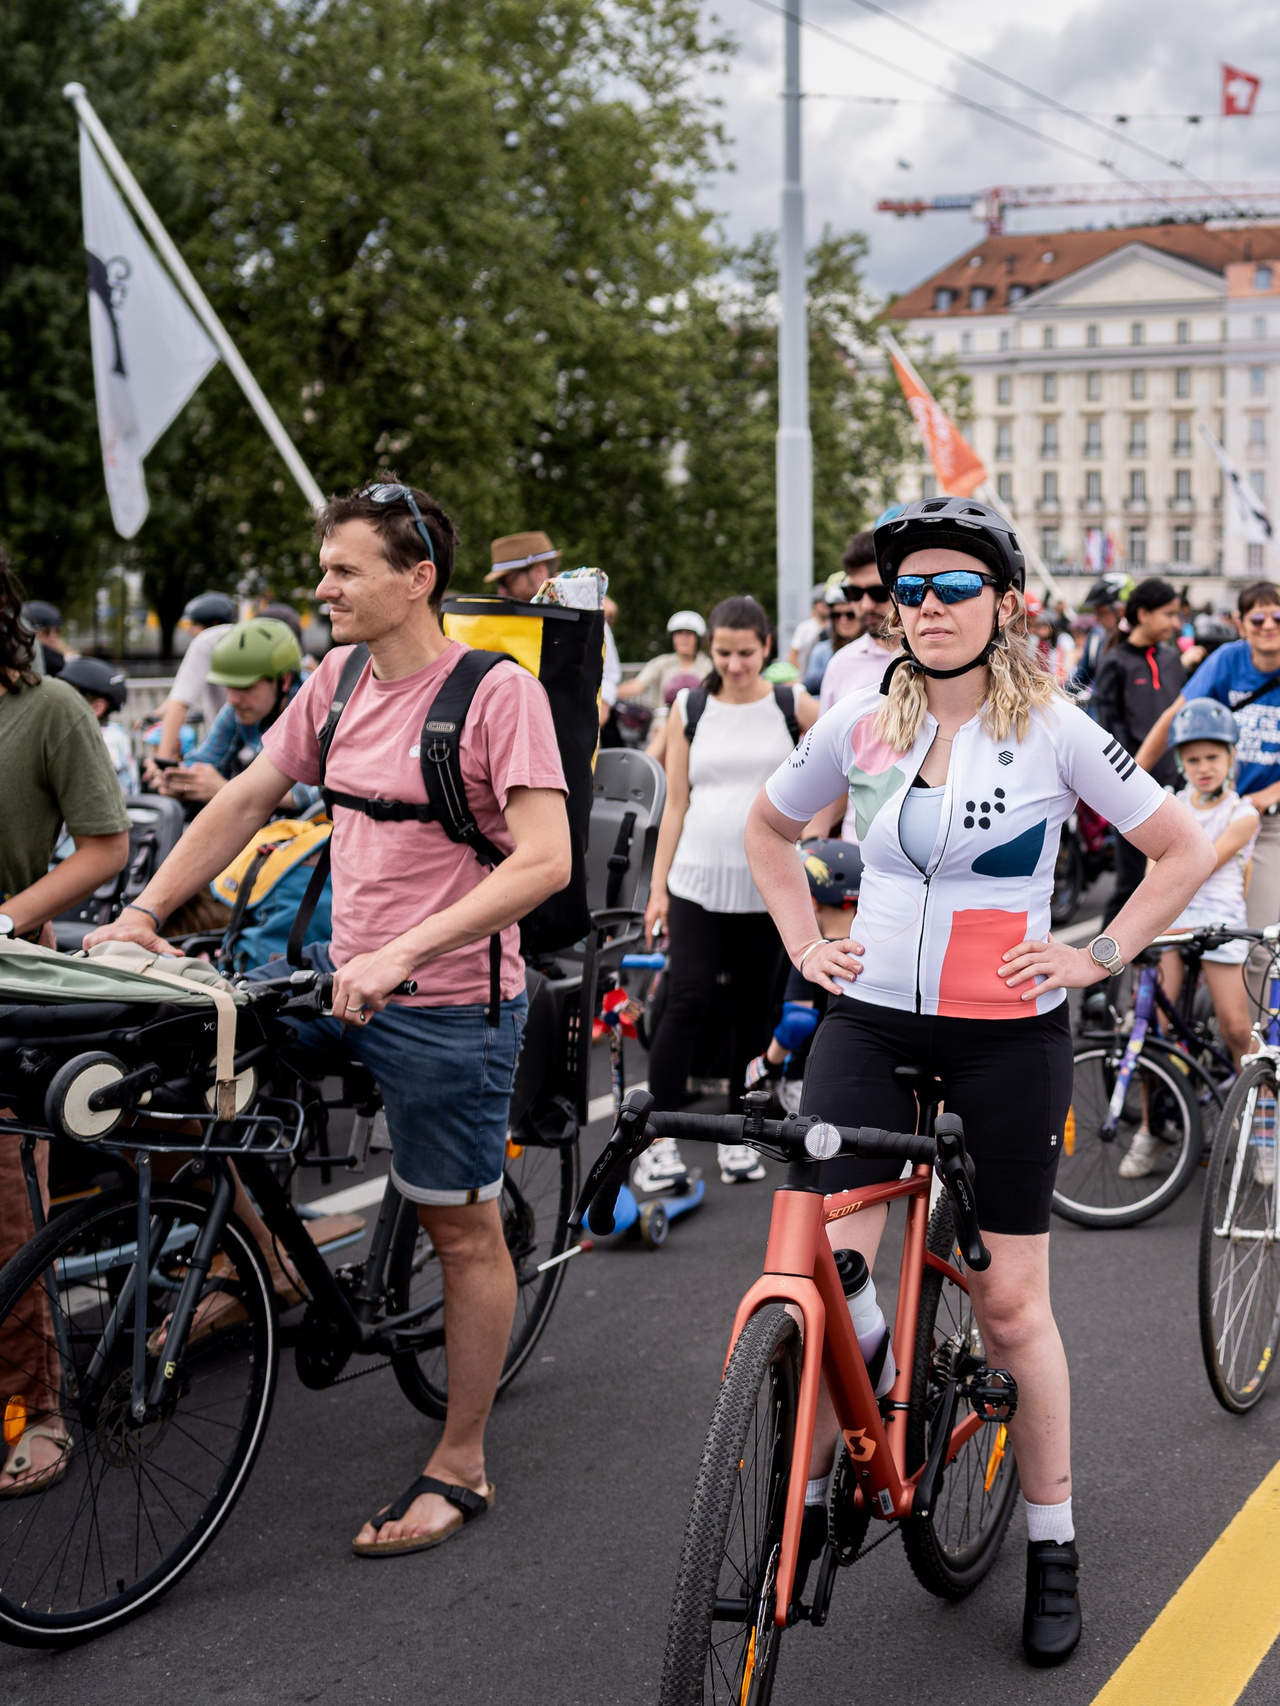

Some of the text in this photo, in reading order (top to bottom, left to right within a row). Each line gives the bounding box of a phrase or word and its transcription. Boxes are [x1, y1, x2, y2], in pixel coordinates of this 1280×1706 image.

[592, 1150, 612, 1180] GRX
[826, 1200, 864, 1220] SCOTT
[956, 1179, 971, 1211] GRX
